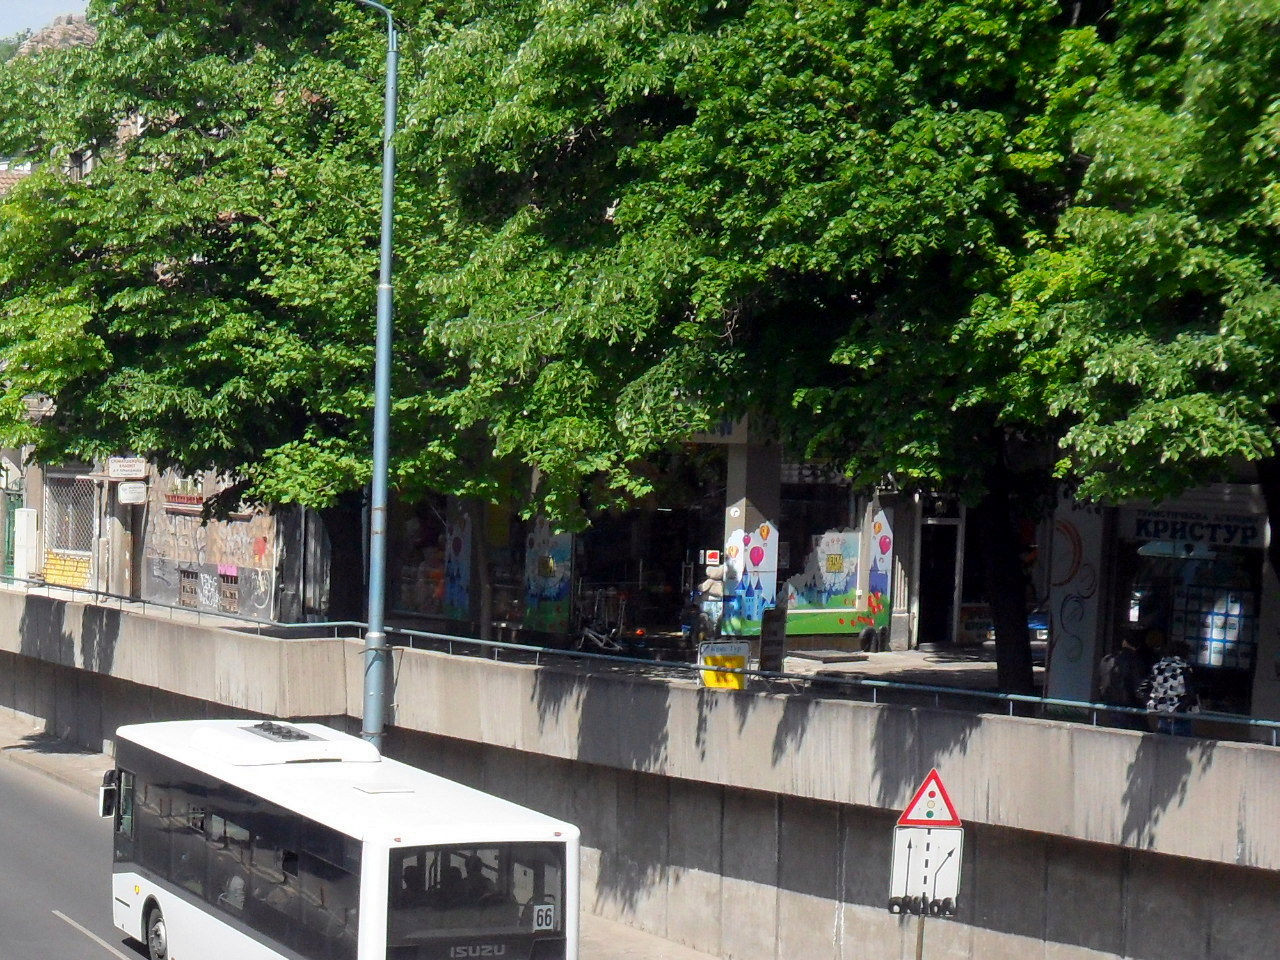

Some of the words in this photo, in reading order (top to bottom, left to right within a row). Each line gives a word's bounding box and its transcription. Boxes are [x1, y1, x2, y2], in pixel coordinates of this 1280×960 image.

[1135, 518, 1259, 544] КРИСТУР
[536, 907, 553, 927] 66
[450, 944, 506, 958] ISUZU
